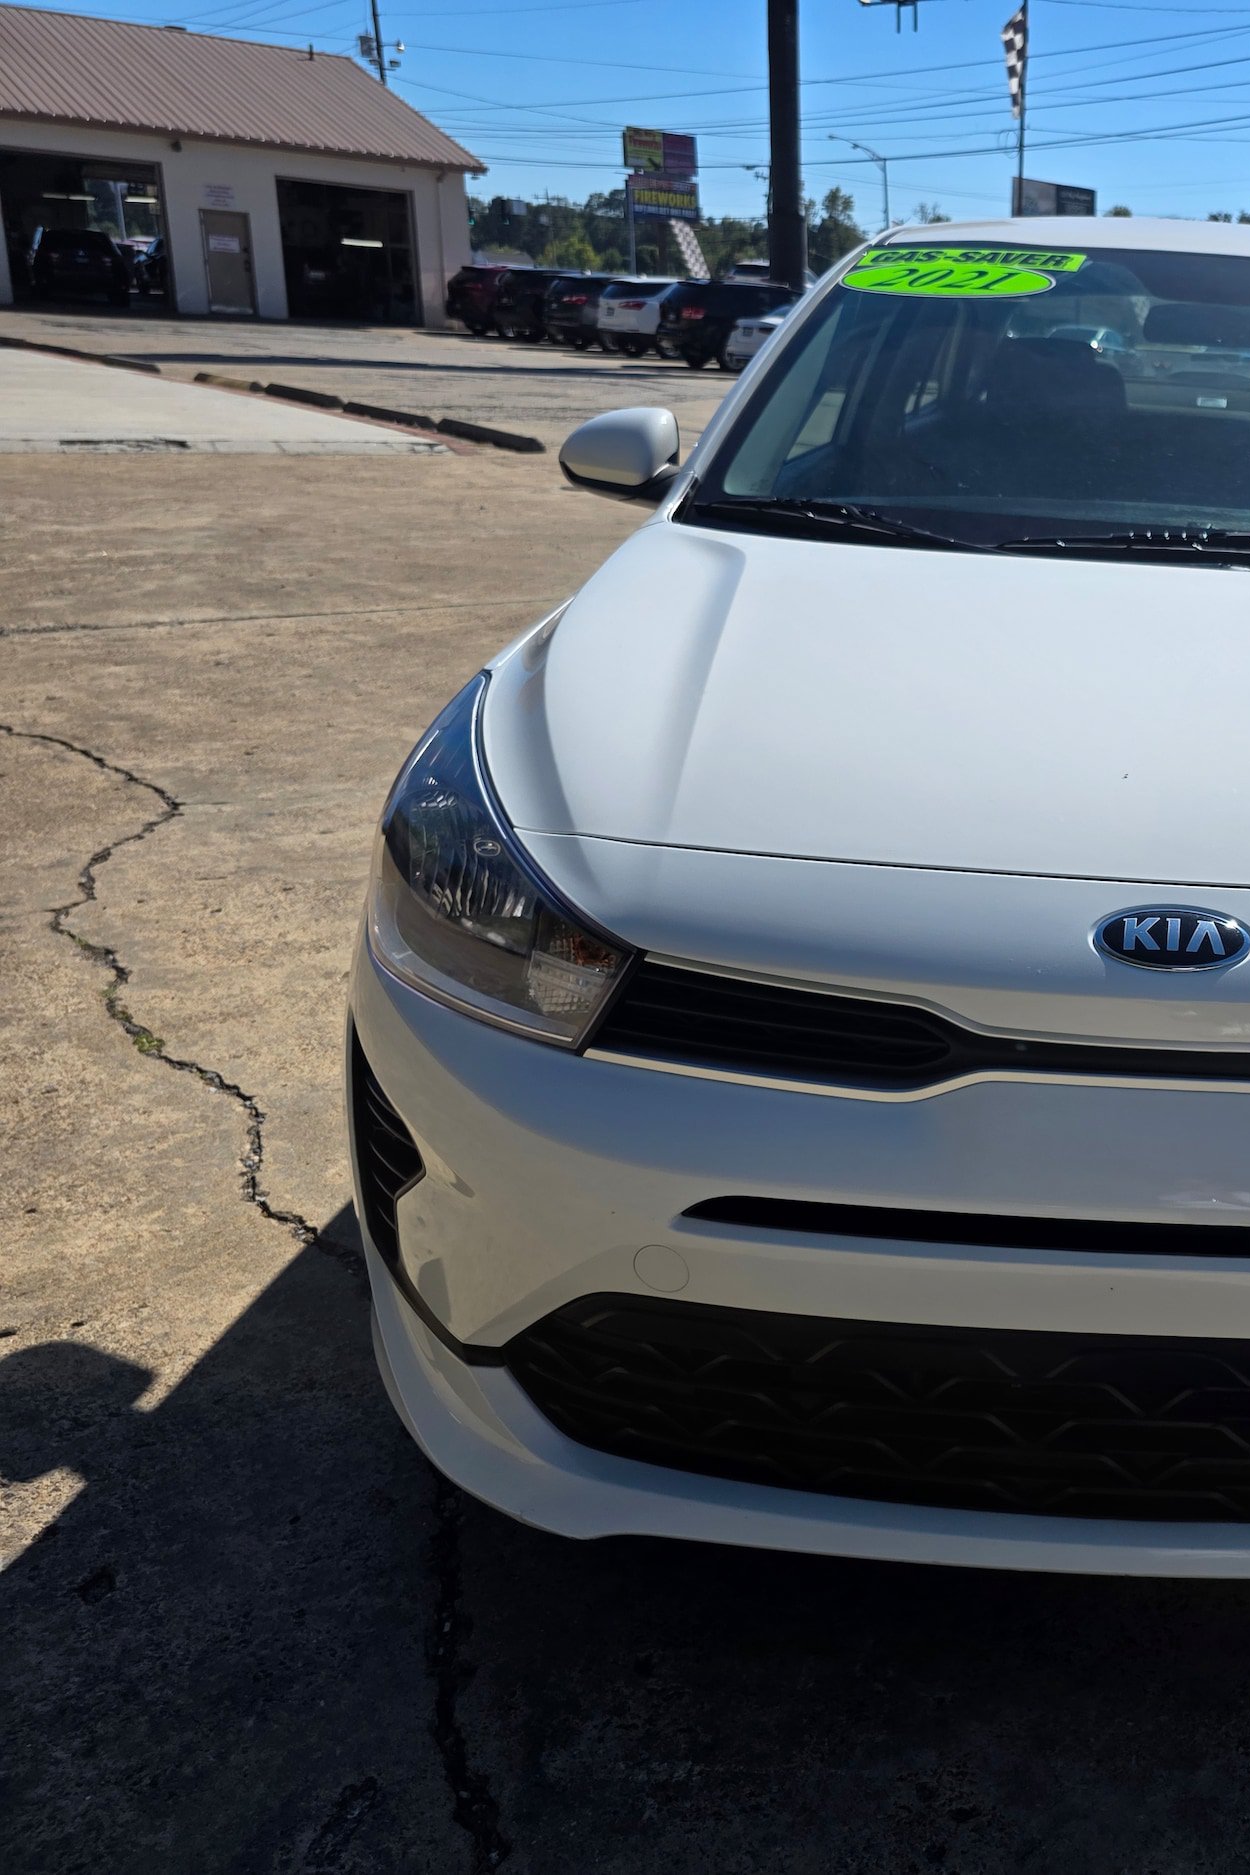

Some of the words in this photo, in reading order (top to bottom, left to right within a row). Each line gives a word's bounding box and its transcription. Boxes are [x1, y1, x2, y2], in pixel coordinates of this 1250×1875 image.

[634, 189, 696, 209] FIREWORKS
[870, 251, 1071, 269] GAS-SAVER
[868, 268, 1022, 291] 2021
[1123, 917, 1226, 956] KIA
